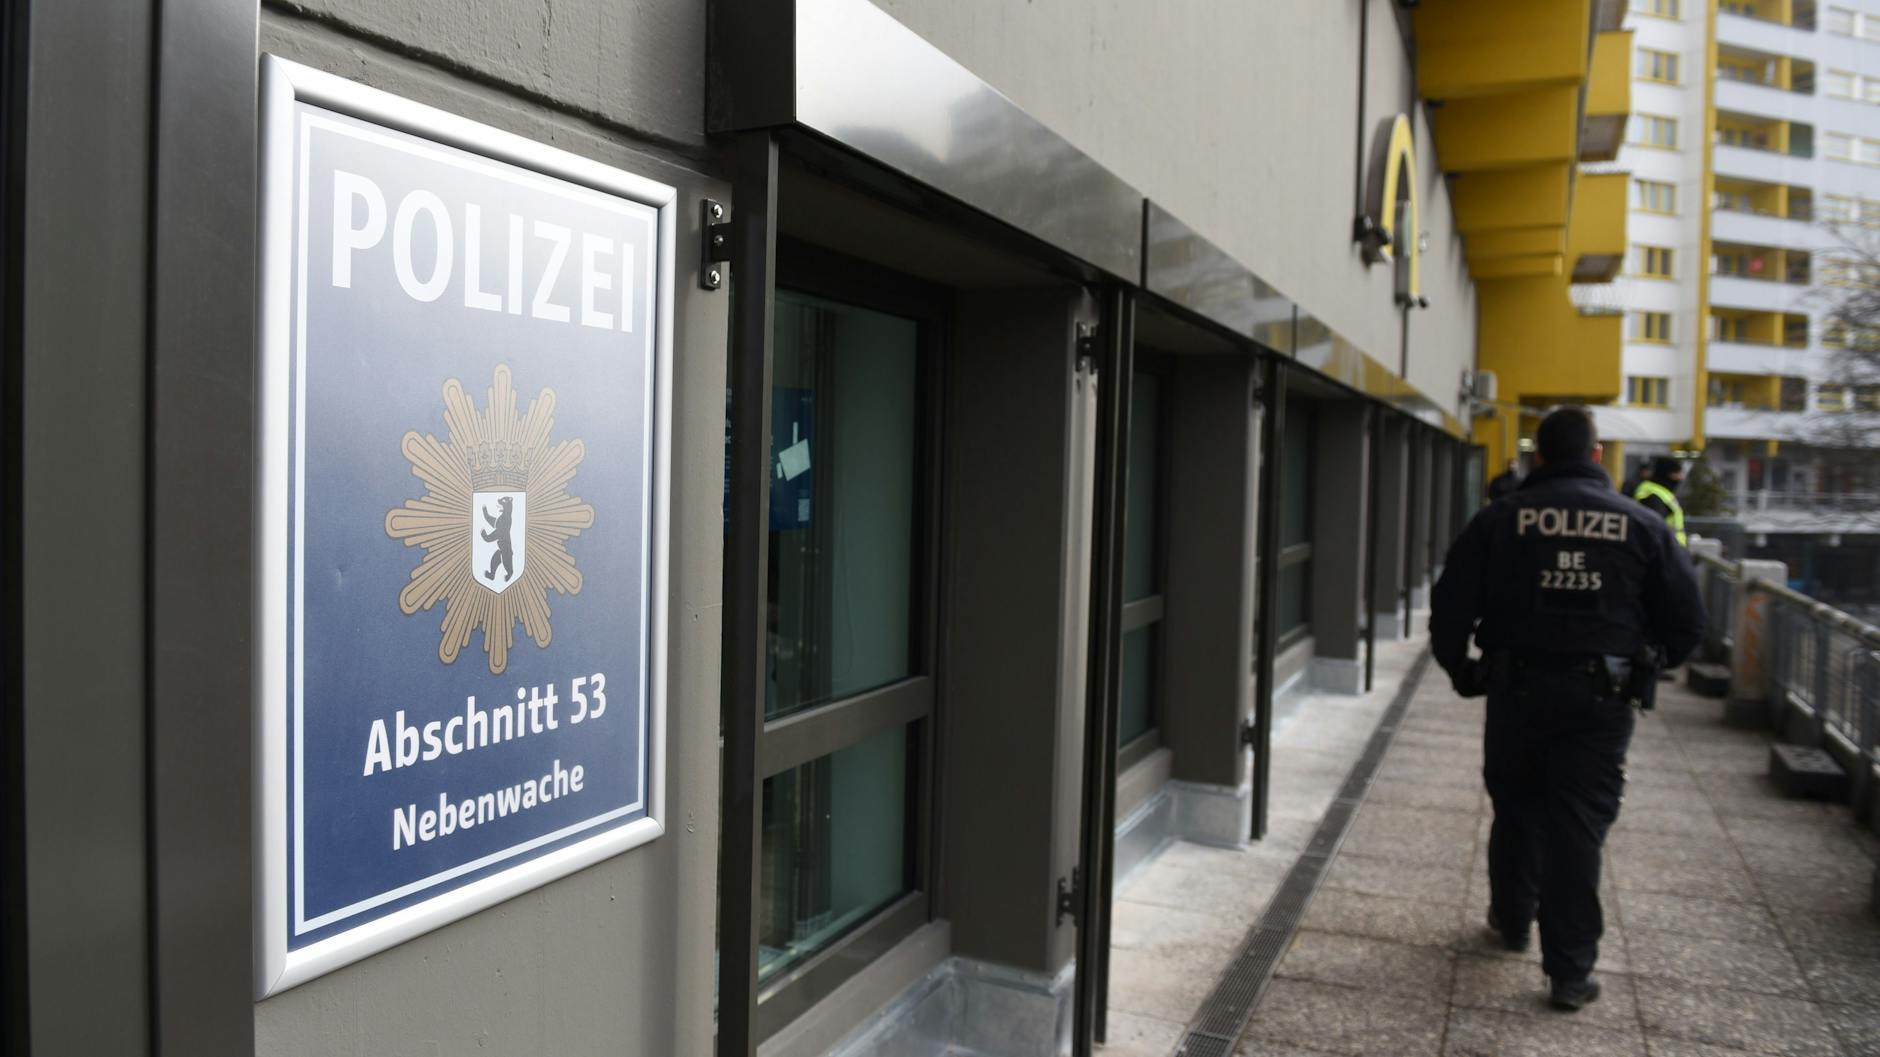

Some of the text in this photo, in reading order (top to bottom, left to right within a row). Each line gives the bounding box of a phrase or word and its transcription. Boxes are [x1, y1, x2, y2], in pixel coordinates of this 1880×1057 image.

[331, 168, 634, 333] POLIZEI
[1518, 508, 1628, 541] POLIZEI
[1541, 570, 1602, 590] 22235
[1558, 551, 1585, 570] BE
[362, 672, 607, 777] Abschnitt 53
[391, 759, 585, 851] Nebenwache
